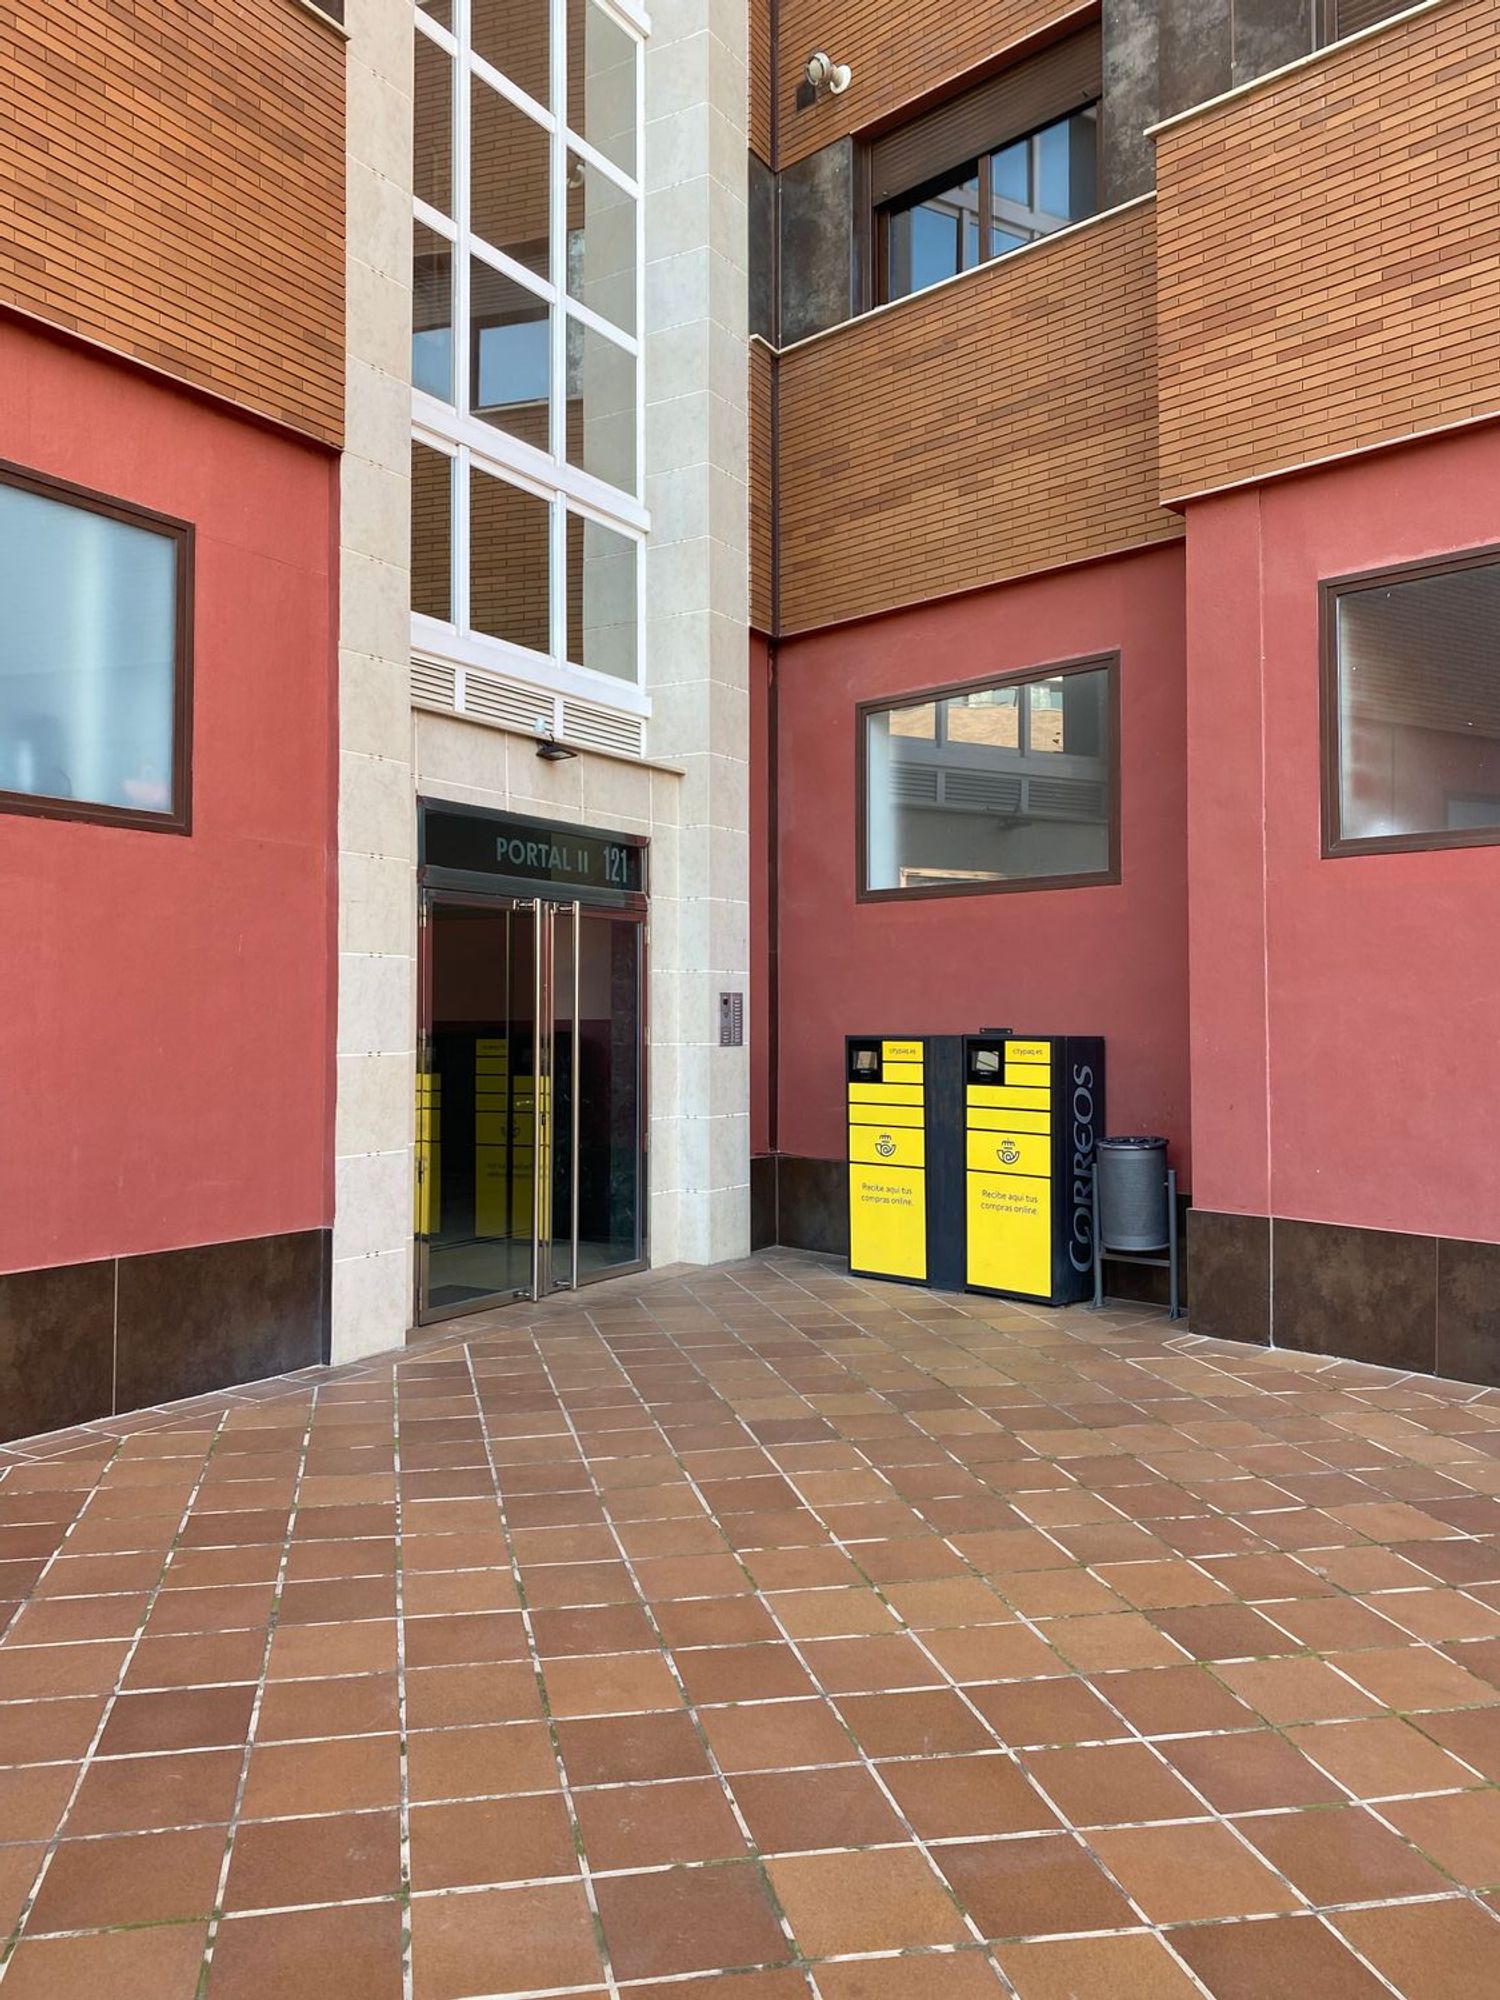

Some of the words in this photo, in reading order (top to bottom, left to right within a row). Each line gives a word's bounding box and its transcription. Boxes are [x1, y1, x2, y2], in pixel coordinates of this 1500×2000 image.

[496, 837, 572, 871] PORTAL
[603, 846, 627, 883] 121
[1069, 1064, 1094, 1272] CORREOS
[861, 1182, 884, 1192] Recibe
[901, 1187, 912, 1195] tus
[861, 1194, 890, 1204] compras
[981, 1189, 1006, 1199] Recibe
[1025, 1195, 1038, 1203] tus
[980, 1202, 1012, 1212] compras
